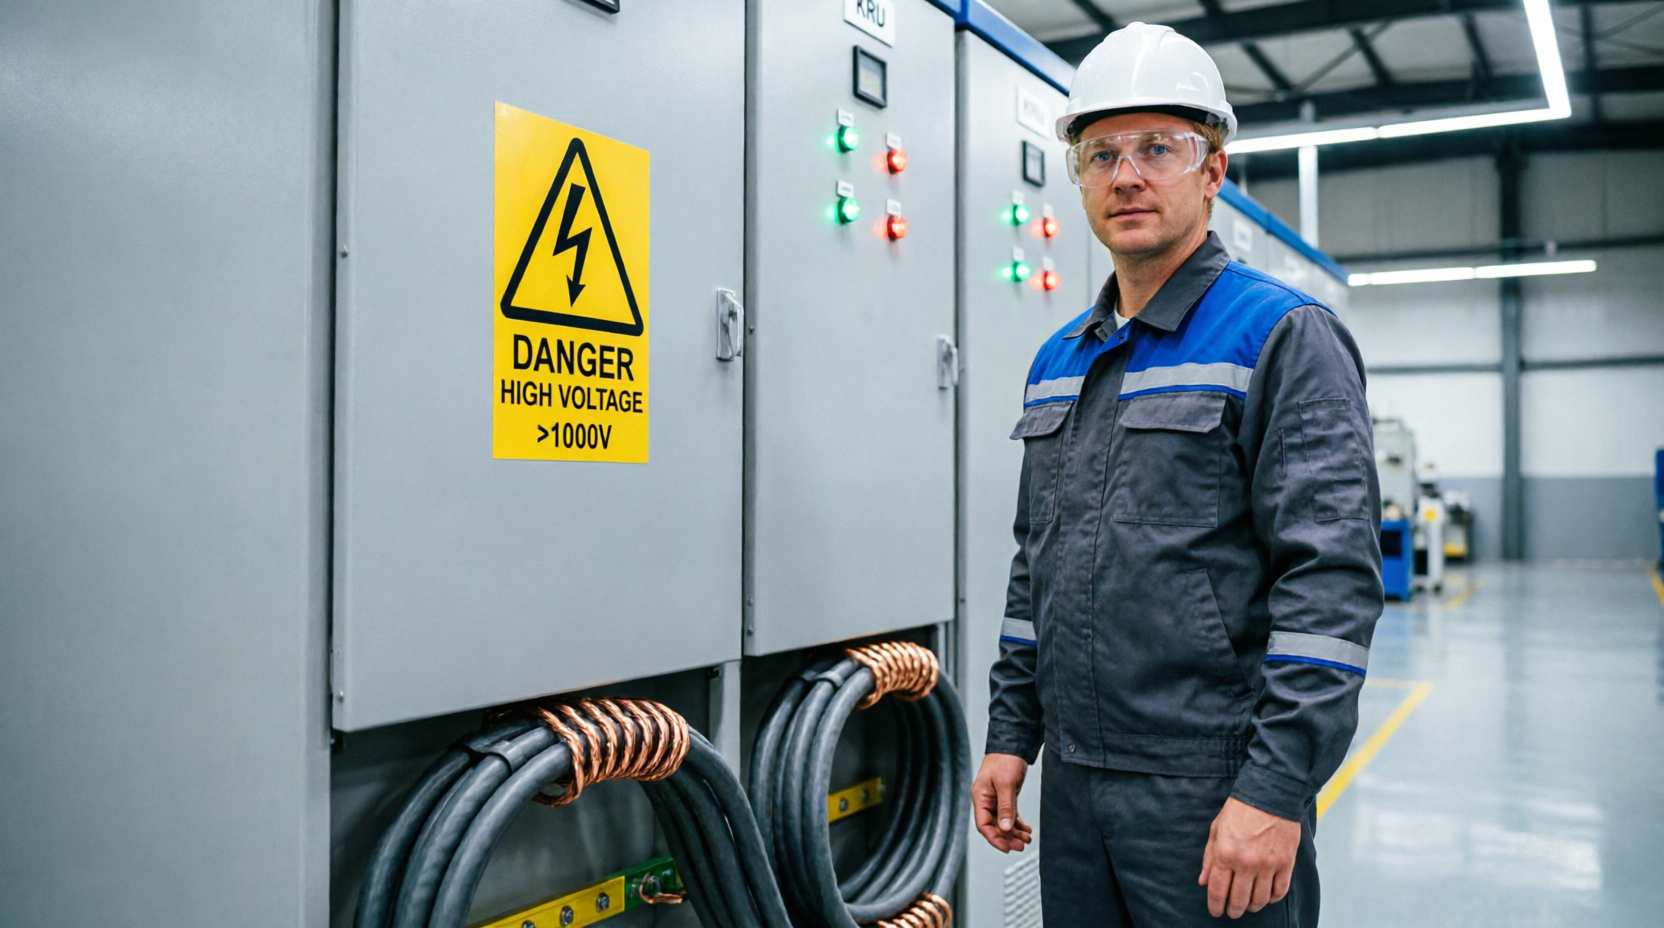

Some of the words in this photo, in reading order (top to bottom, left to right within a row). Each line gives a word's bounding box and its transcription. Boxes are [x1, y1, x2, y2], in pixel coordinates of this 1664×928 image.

[513, 333, 635, 382] DANGER
[501, 379, 552, 407] HIGH
[558, 384, 643, 414] VOLTAGE
[537, 422, 612, 450] >1000V
